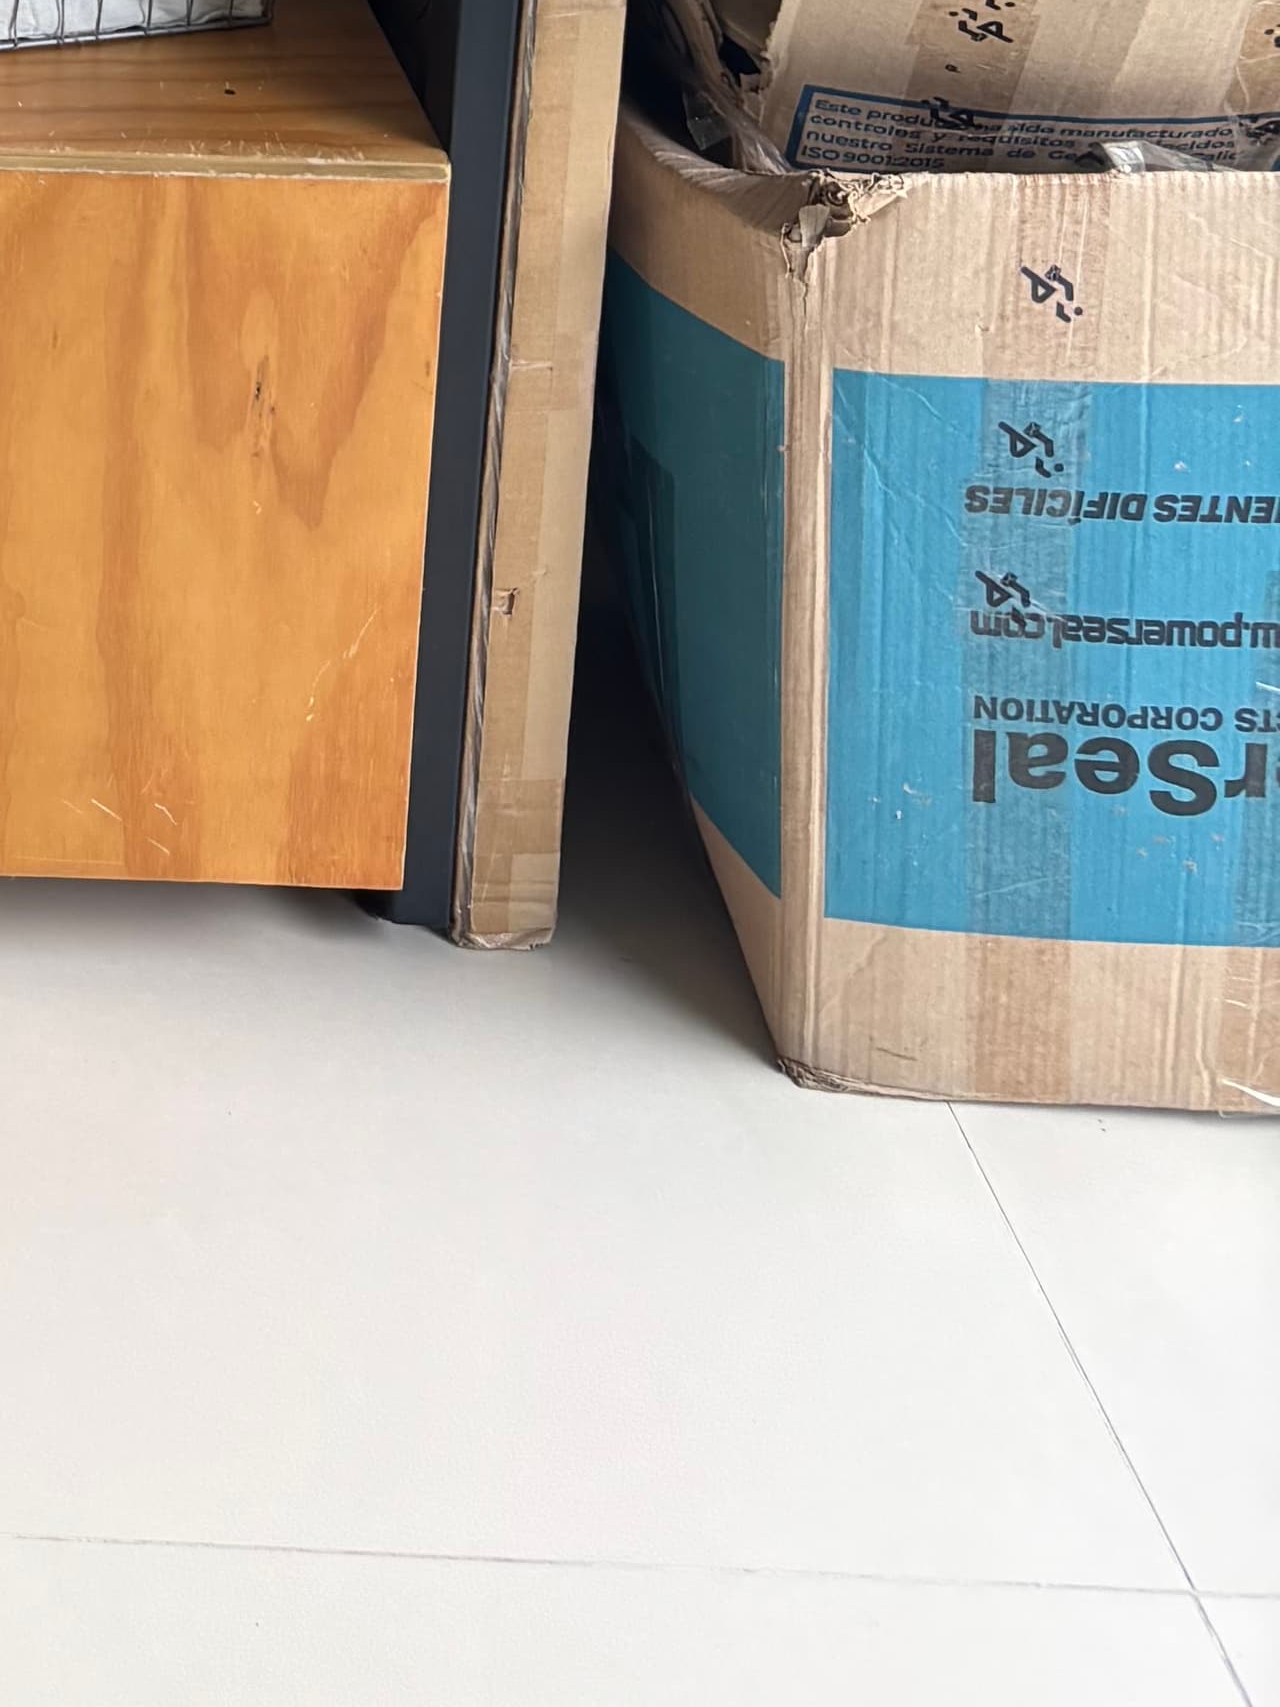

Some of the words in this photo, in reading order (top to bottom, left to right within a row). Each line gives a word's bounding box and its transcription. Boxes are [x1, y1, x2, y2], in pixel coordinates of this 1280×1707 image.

[810, 114, 922, 140] controles
[814, 98, 863, 116] Este
[866, 109, 965, 132] produ
[1059, 126, 1233, 139] manufacturado
[800, 145, 841, 161] ISO
[806, 130, 893, 152] nuestro
[904, 142, 994, 158] Sistema
[1006, 146, 1037, 159] de
[973, 694, 1223, 732] CORPORATION
[972, 729, 1280, 816] rSeal
